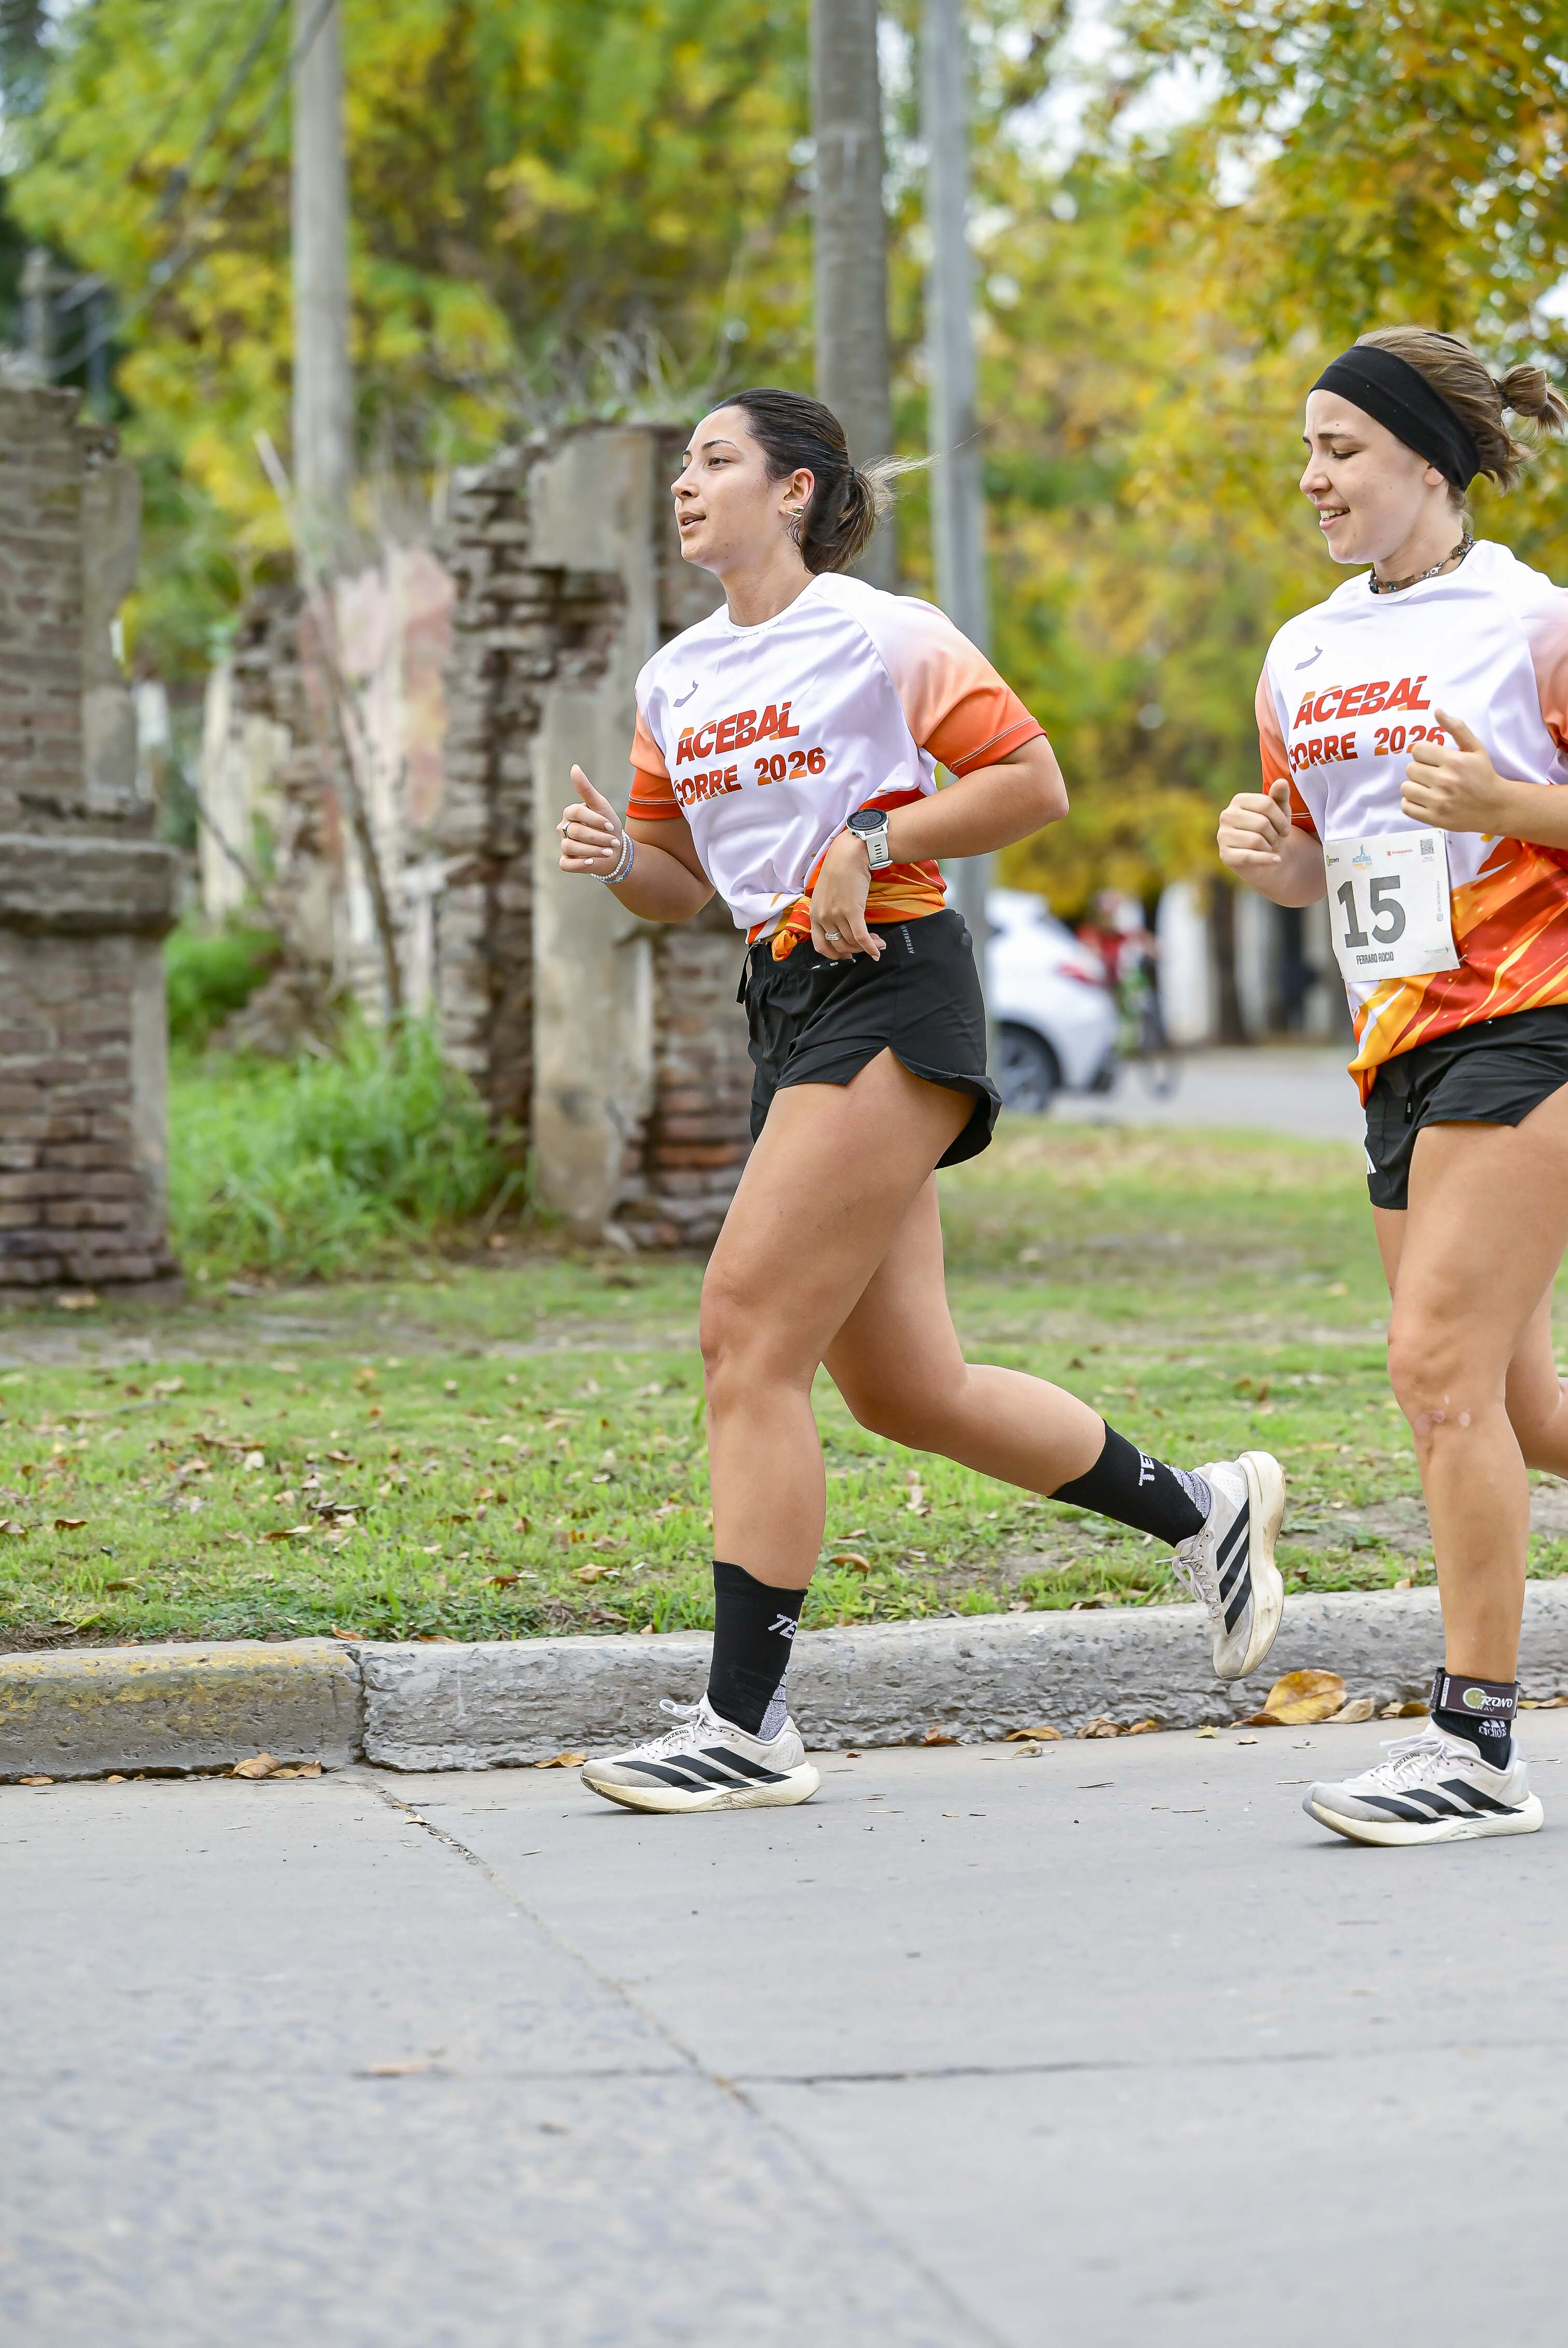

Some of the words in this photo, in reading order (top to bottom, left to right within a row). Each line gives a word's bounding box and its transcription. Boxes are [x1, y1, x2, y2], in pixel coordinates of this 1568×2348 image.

[1293, 675, 1431, 730] ACEBAL
[676, 701, 800, 765] ACEBAL
[1374, 725, 1447, 756] 2026
[674, 765, 743, 807] CORRE
[754, 747, 826, 786] 2026
[1337, 875, 1406, 948] 15
[900, 925, 915, 954] AEROREAD
[1356, 954, 1378, 965] FERRARO
[1378, 951, 1394, 962] ROCIO
[1138, 1451, 1155, 1487] TE
